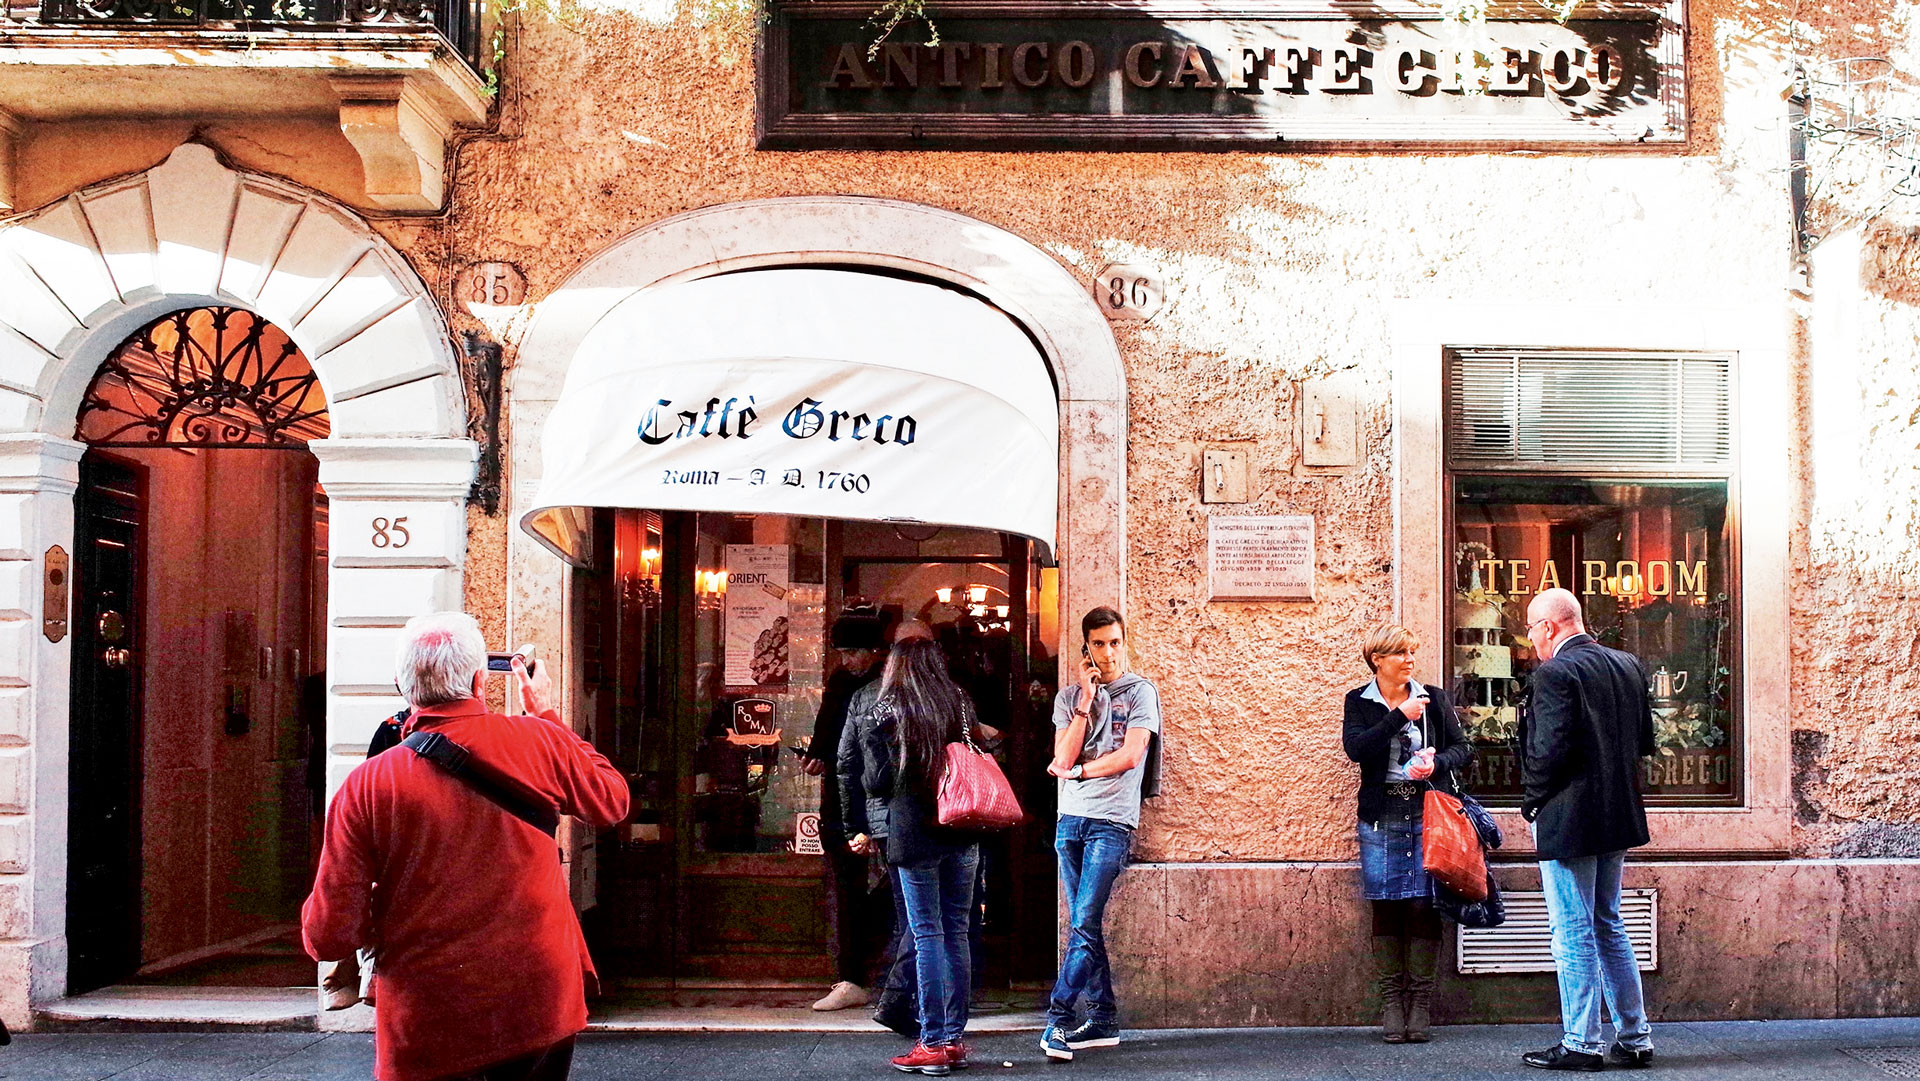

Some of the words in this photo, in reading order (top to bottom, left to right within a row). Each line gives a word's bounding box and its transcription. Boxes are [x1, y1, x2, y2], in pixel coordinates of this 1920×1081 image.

[819, 40, 1096, 89] ANTICO
[1385, 44, 1628, 96] GRECO
[472, 275, 509, 304] 85
[1109, 277, 1148, 309] 86
[637, 395, 758, 445] Caffè
[781, 396, 917, 446] Greco
[660, 469, 720, 486] Roma
[781, 468, 806, 490] D.
[818, 470, 870, 494] 1760
[371, 516, 410, 549] 85
[727, 573, 767, 584] ORIENT
[1480, 560, 1562, 595] TEA
[1582, 560, 1708, 596] ROOM
[737, 705, 767, 734] ROMA
